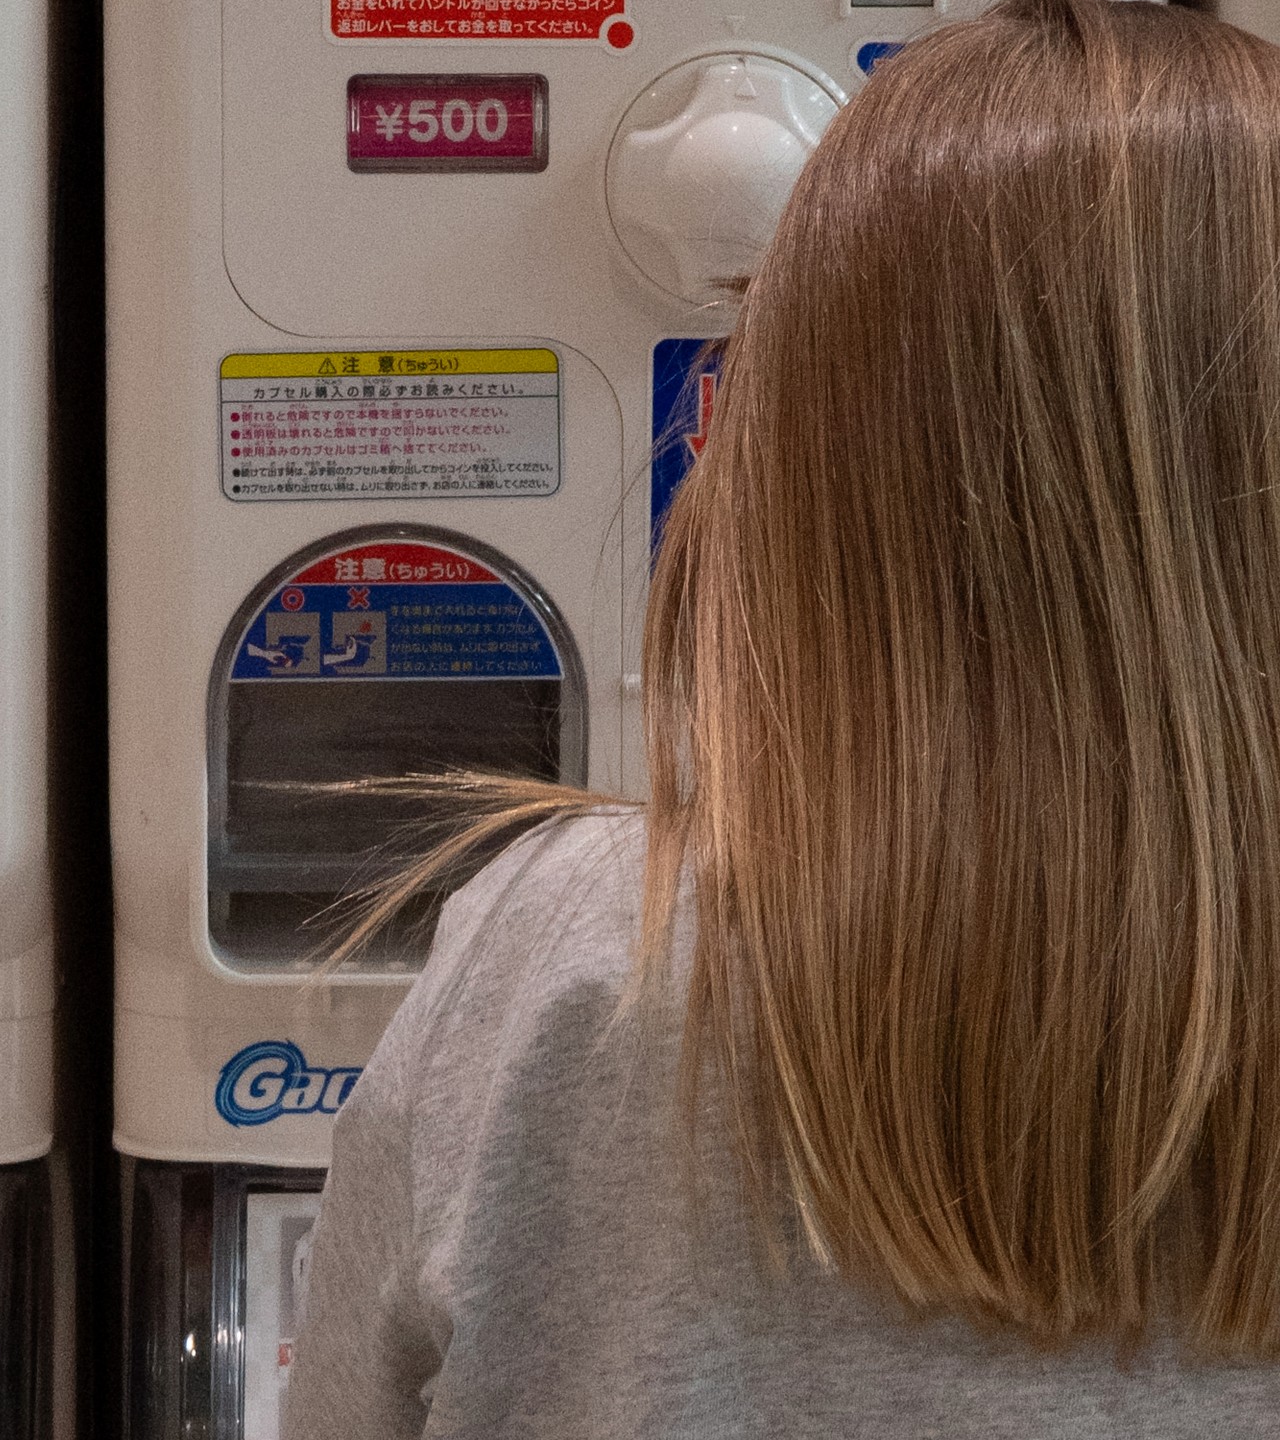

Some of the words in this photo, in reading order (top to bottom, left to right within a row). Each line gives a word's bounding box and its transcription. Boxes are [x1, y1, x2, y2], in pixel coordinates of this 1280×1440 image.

[375, 98, 508, 143] ¥500
[334, 557, 470, 581] 注意(ちゅうい)
